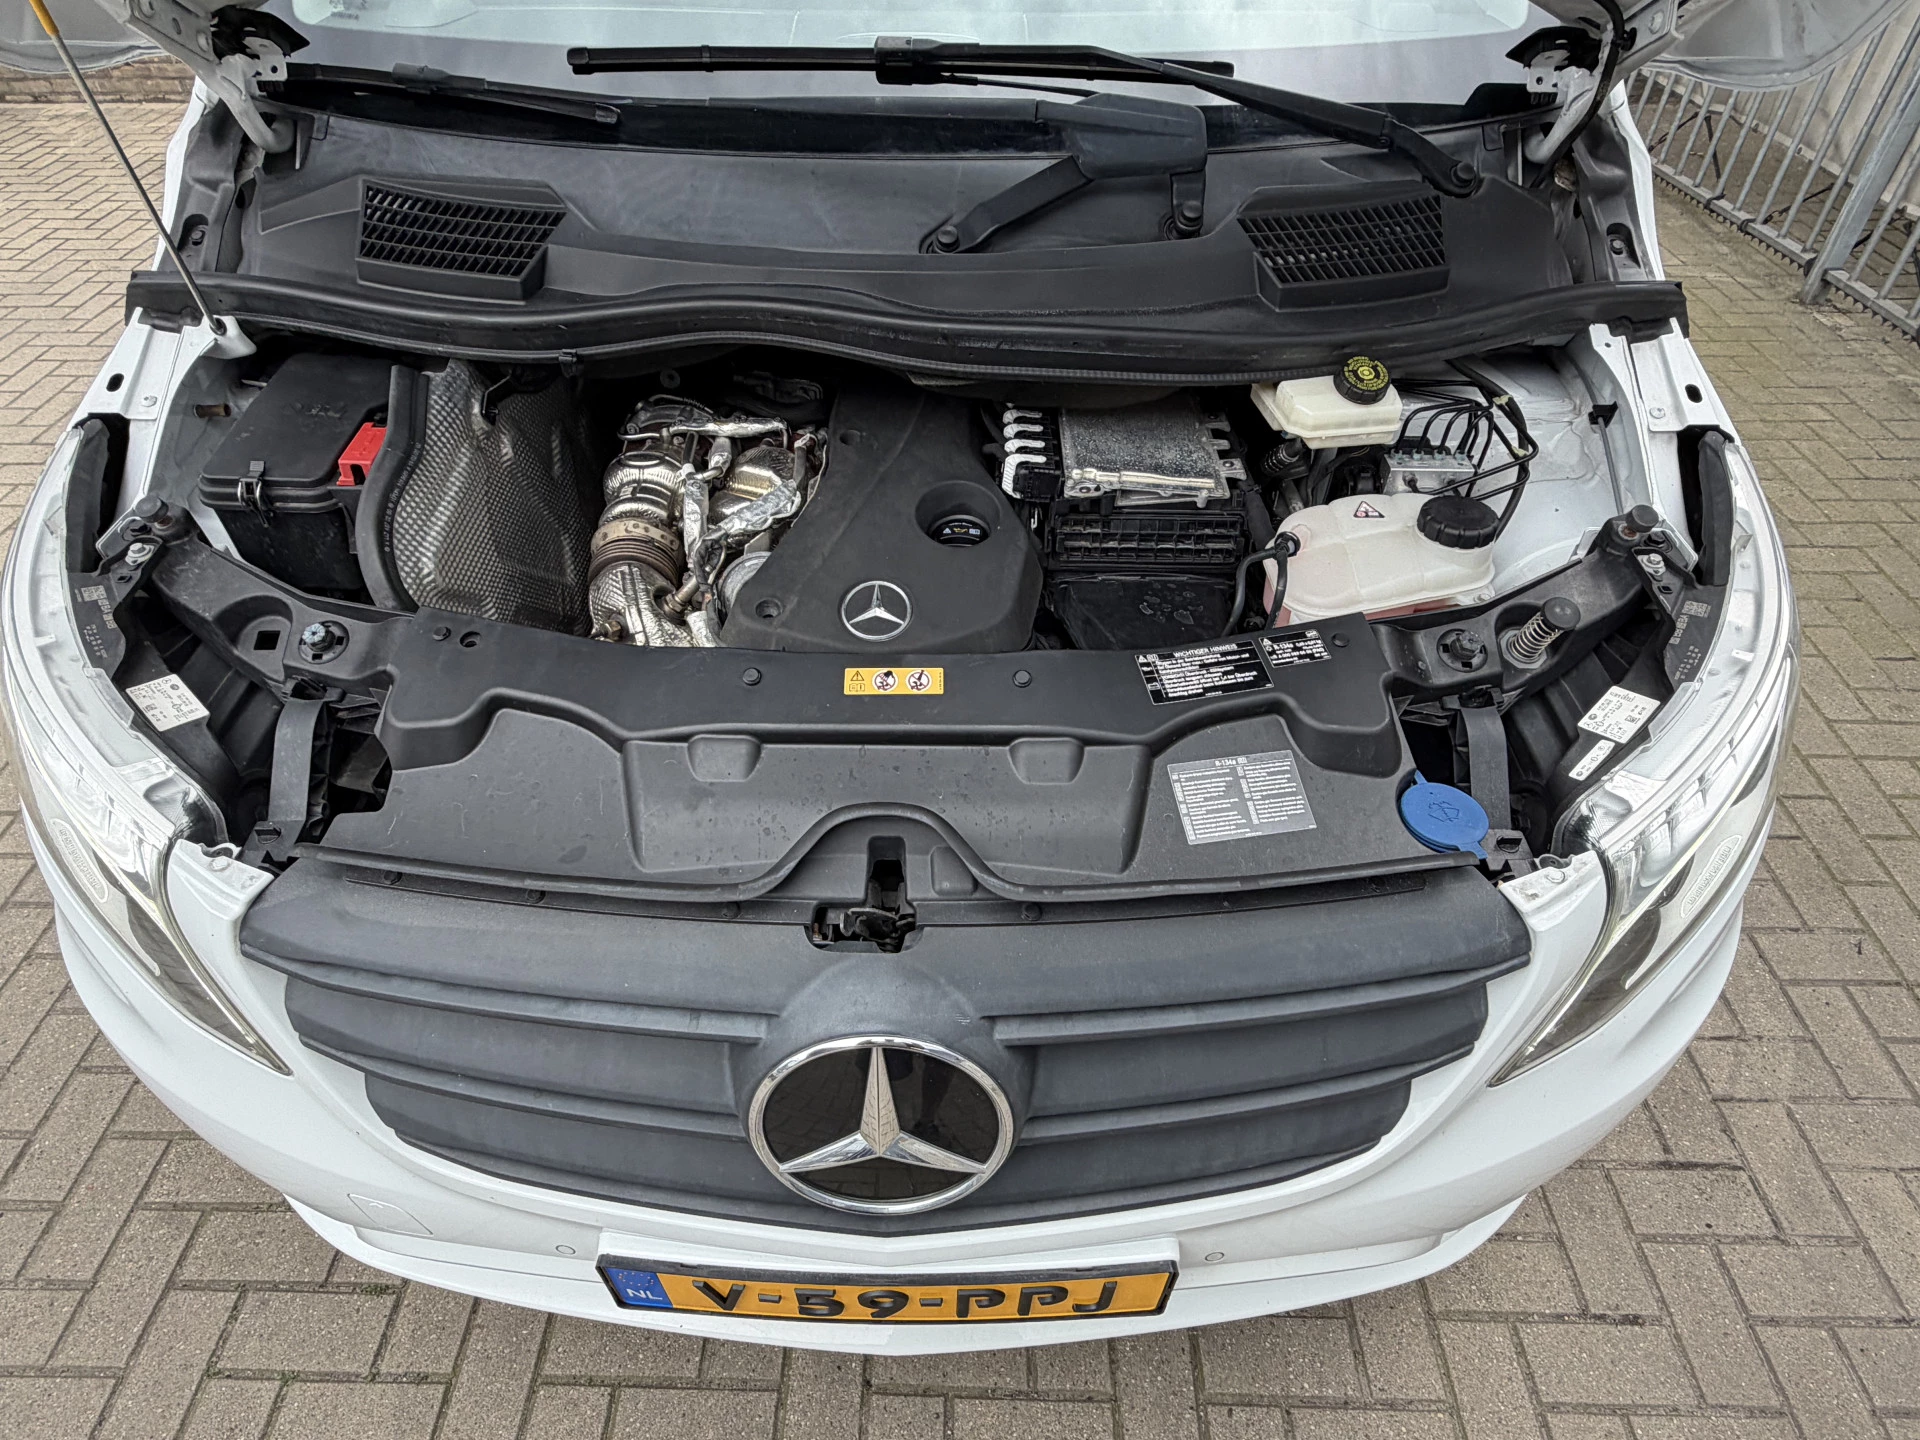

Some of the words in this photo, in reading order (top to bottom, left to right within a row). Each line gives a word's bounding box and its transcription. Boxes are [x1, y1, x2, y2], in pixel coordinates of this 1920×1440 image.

[1173, 648, 1210, 658] WICHTIGER
[1210, 643, 1238, 653] HINWEIS
[1273, 642, 1294, 650] R-134a
[1214, 758, 1236, 766] R-134a
[627, 1288, 663, 1300] NL
[692, 1280, 1118, 1318] V-59-PPJ
